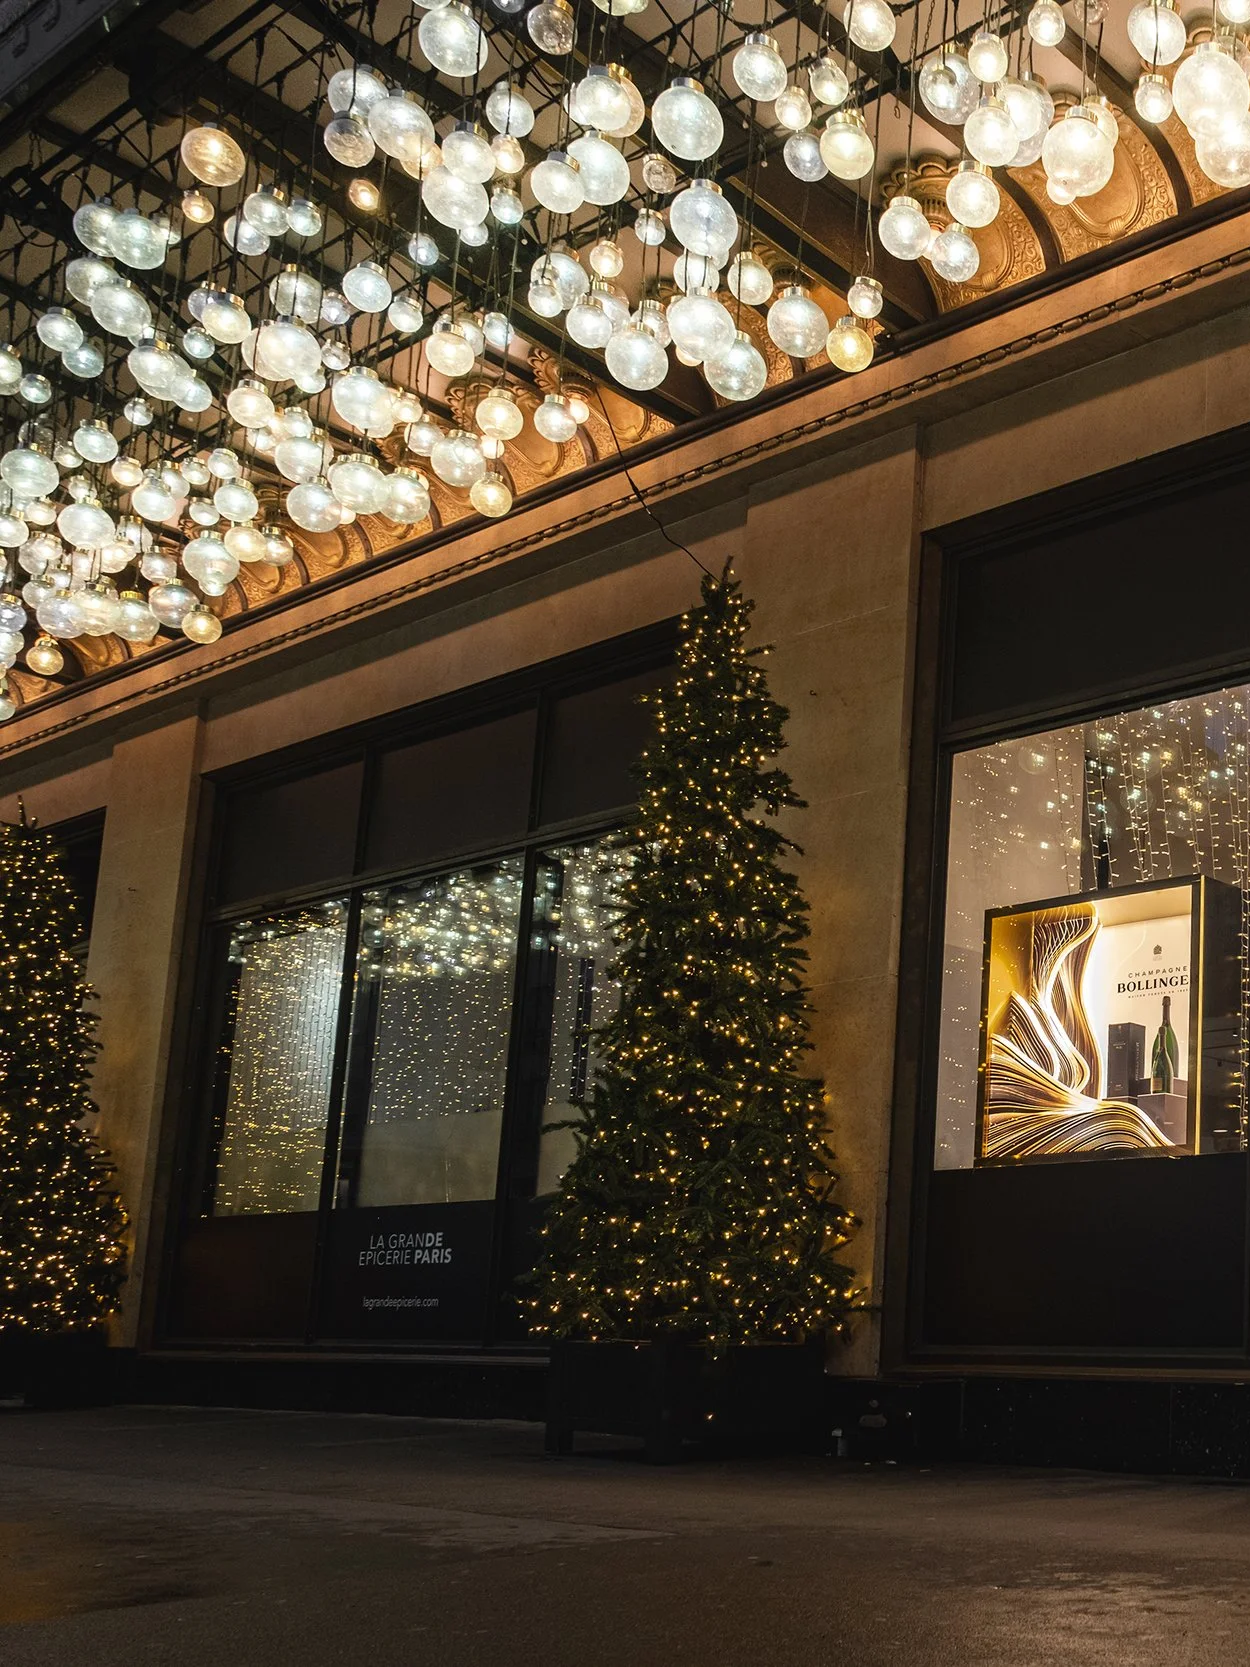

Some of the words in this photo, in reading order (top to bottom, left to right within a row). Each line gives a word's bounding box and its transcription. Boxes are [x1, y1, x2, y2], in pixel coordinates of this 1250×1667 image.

[1128, 965, 1188, 978] CHAMPAGNE
[1117, 974, 1189, 993] BOLLINGE
[370, 1235, 385, 1249] LA
[388, 1232, 444, 1249] GRANDE
[358, 1249, 411, 1266] EPICERIE
[414, 1248, 452, 1265] PARIS
[362, 1296, 439, 1310] lagrandeepicerie.com
